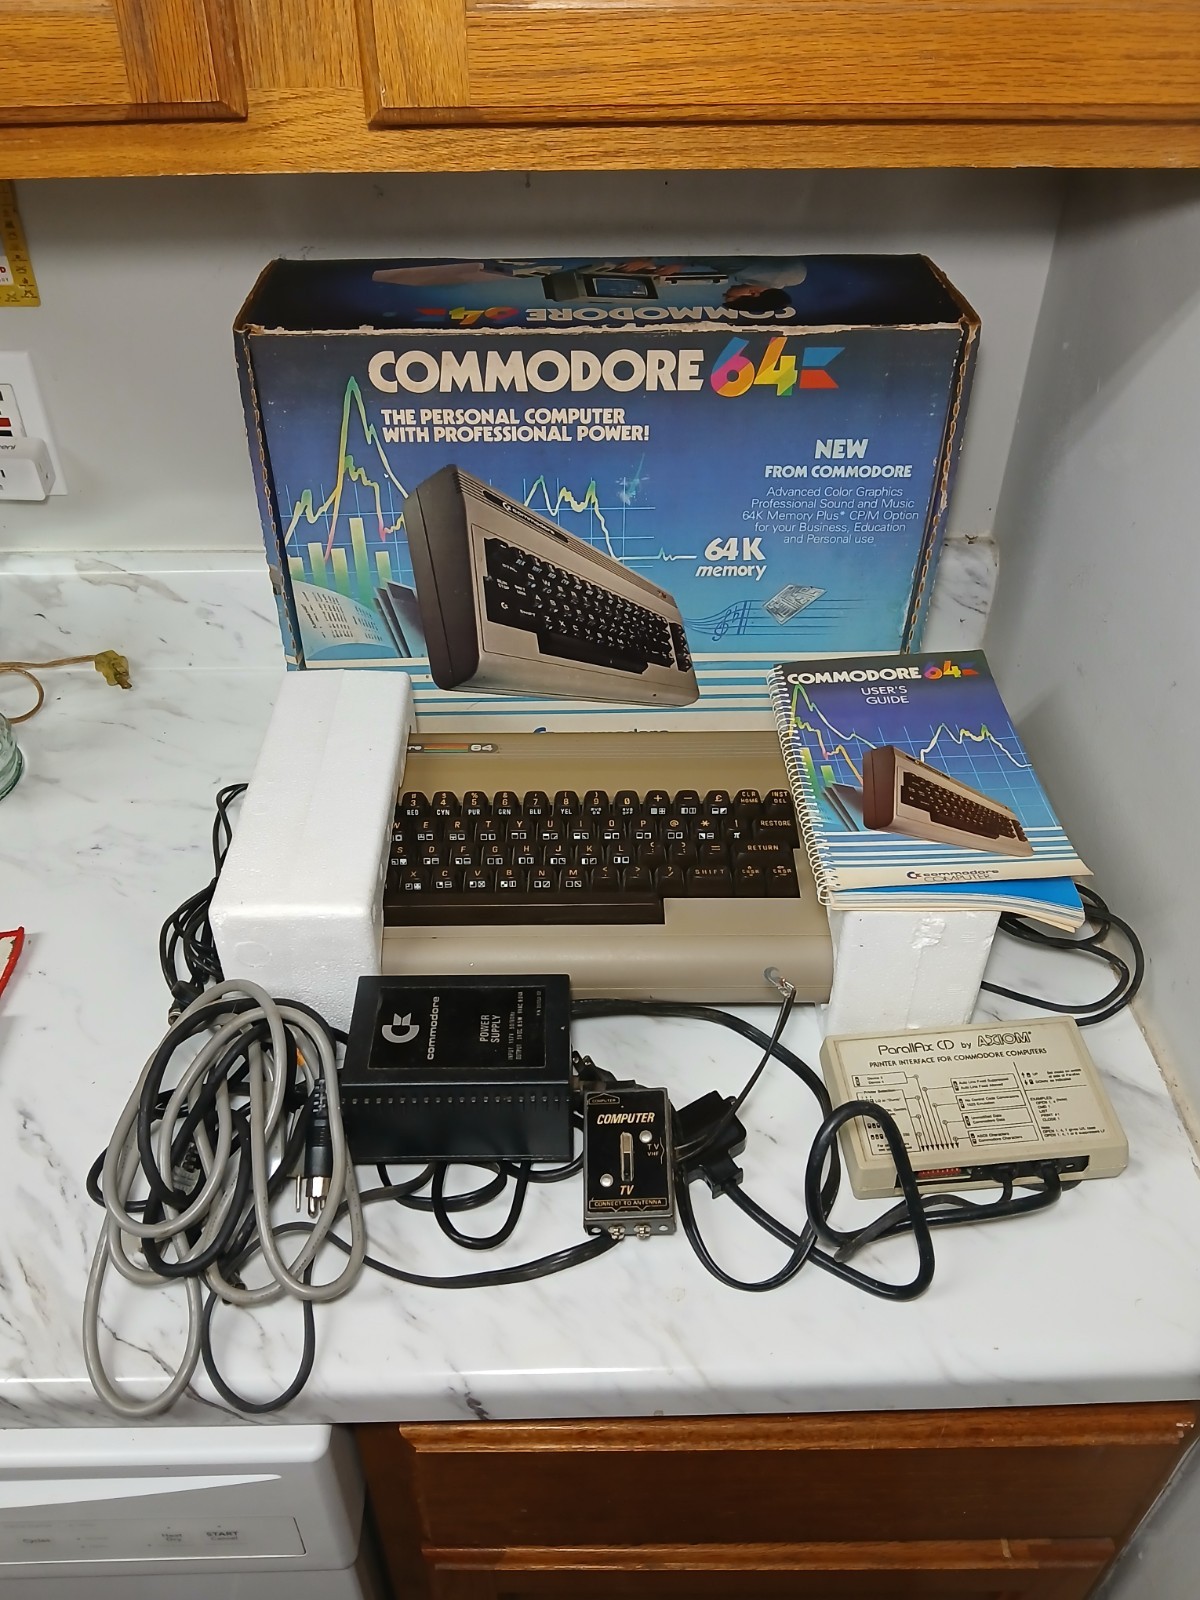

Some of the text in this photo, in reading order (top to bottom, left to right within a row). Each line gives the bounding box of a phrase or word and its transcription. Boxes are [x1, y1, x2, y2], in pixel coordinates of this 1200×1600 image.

[368, 336, 798, 398] COMMODORE 64
[381, 408, 625, 425] THE PERSONAL COMPUTER
[382, 425, 650, 443] WITH PROFESSIONAL POWER!
[814, 438, 868, 460] NEW
[765, 465, 912, 478] FROM COMMODORE
[766, 486, 903, 498] Advanced Color Graphics
[752, 499, 914, 509] Professional Sound and Music
[742, 511, 764, 521] 64K
[767, 511, 813, 522] Memory
[849, 511, 879, 520] CP/M
[883, 511, 918, 522] Option
[754, 523, 906, 534] for your Business, Education
[784, 535, 874, 544] and Personal use
[696, 565, 767, 580] memory
[788, 660, 962, 684] COMMODORE 64
[861, 686, 908, 696] USER'S
[866, 696, 910, 704] GUIDE
[924, 874, 992, 882] COMPUTER
[427, 996, 440, 1060] commodore
[480, 1014, 490, 1042] POWER
[490, 1014, 500, 1043] SUPPLY
[937, 1040, 954, 1050] CD
[978, 1032, 1030, 1047] AXIOM
[870, 1060, 897, 1068] PRINTER
[900, 1057, 935, 1066] INTERFACE
[954, 1052, 1004, 1062] COMMODORE
[1006, 1048, 1047, 1057] COMPUTERS
[597, 1112, 655, 1125] COMPUTER
[620, 1185, 634, 1196] TV
